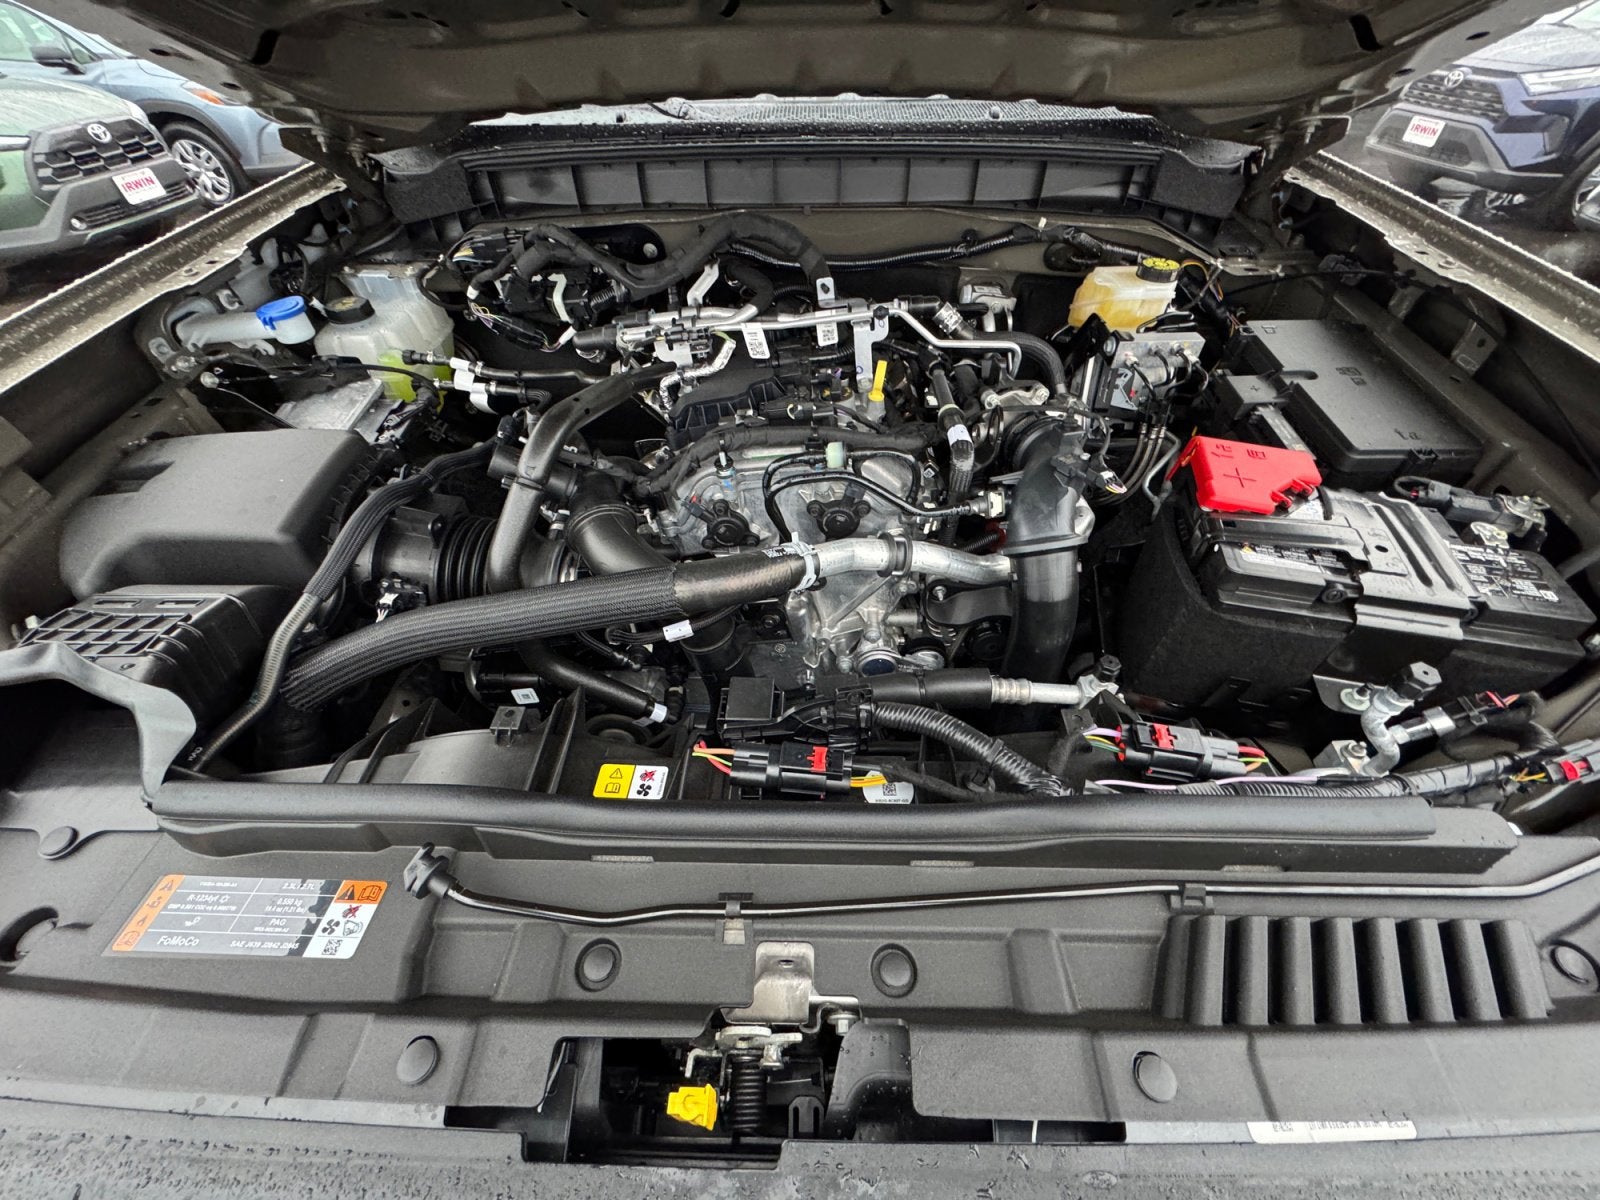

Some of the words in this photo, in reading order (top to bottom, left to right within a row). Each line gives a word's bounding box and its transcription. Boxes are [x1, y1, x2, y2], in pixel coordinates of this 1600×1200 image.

[1410, 124, 1438, 136] IRWIN
[122, 176, 155, 192] IRWIN
[269, 918, 287, 926] PAG
[157, 935, 200, 946] FoMoCo
